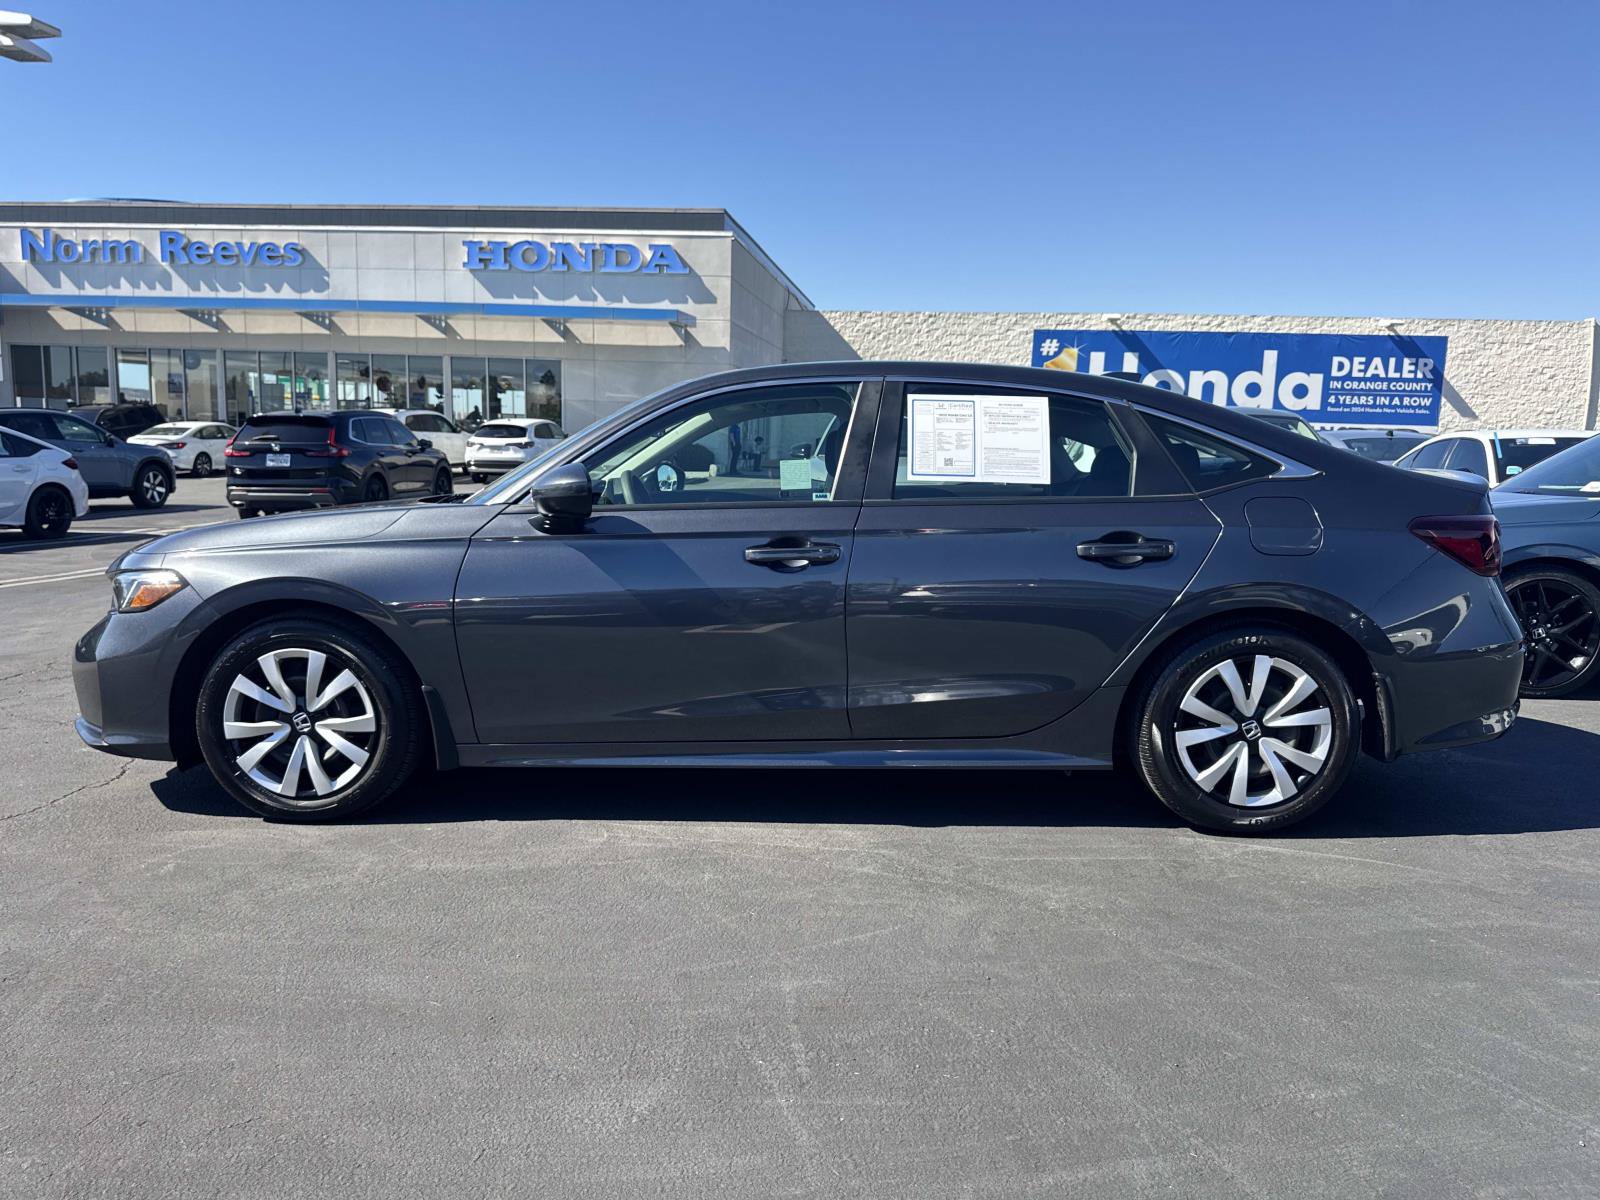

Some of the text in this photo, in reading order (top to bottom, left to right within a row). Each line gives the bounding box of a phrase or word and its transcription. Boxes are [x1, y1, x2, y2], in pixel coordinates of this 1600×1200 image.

[20, 228, 304, 266] Norm Reeves
[462, 240, 689, 274] HONDA
[1331, 356, 1435, 379] DEALER
[1330, 381, 1433, 391] IN ORANGE COUNTY
[1328, 395, 1433, 407] 4 YEARS IN A ROW
